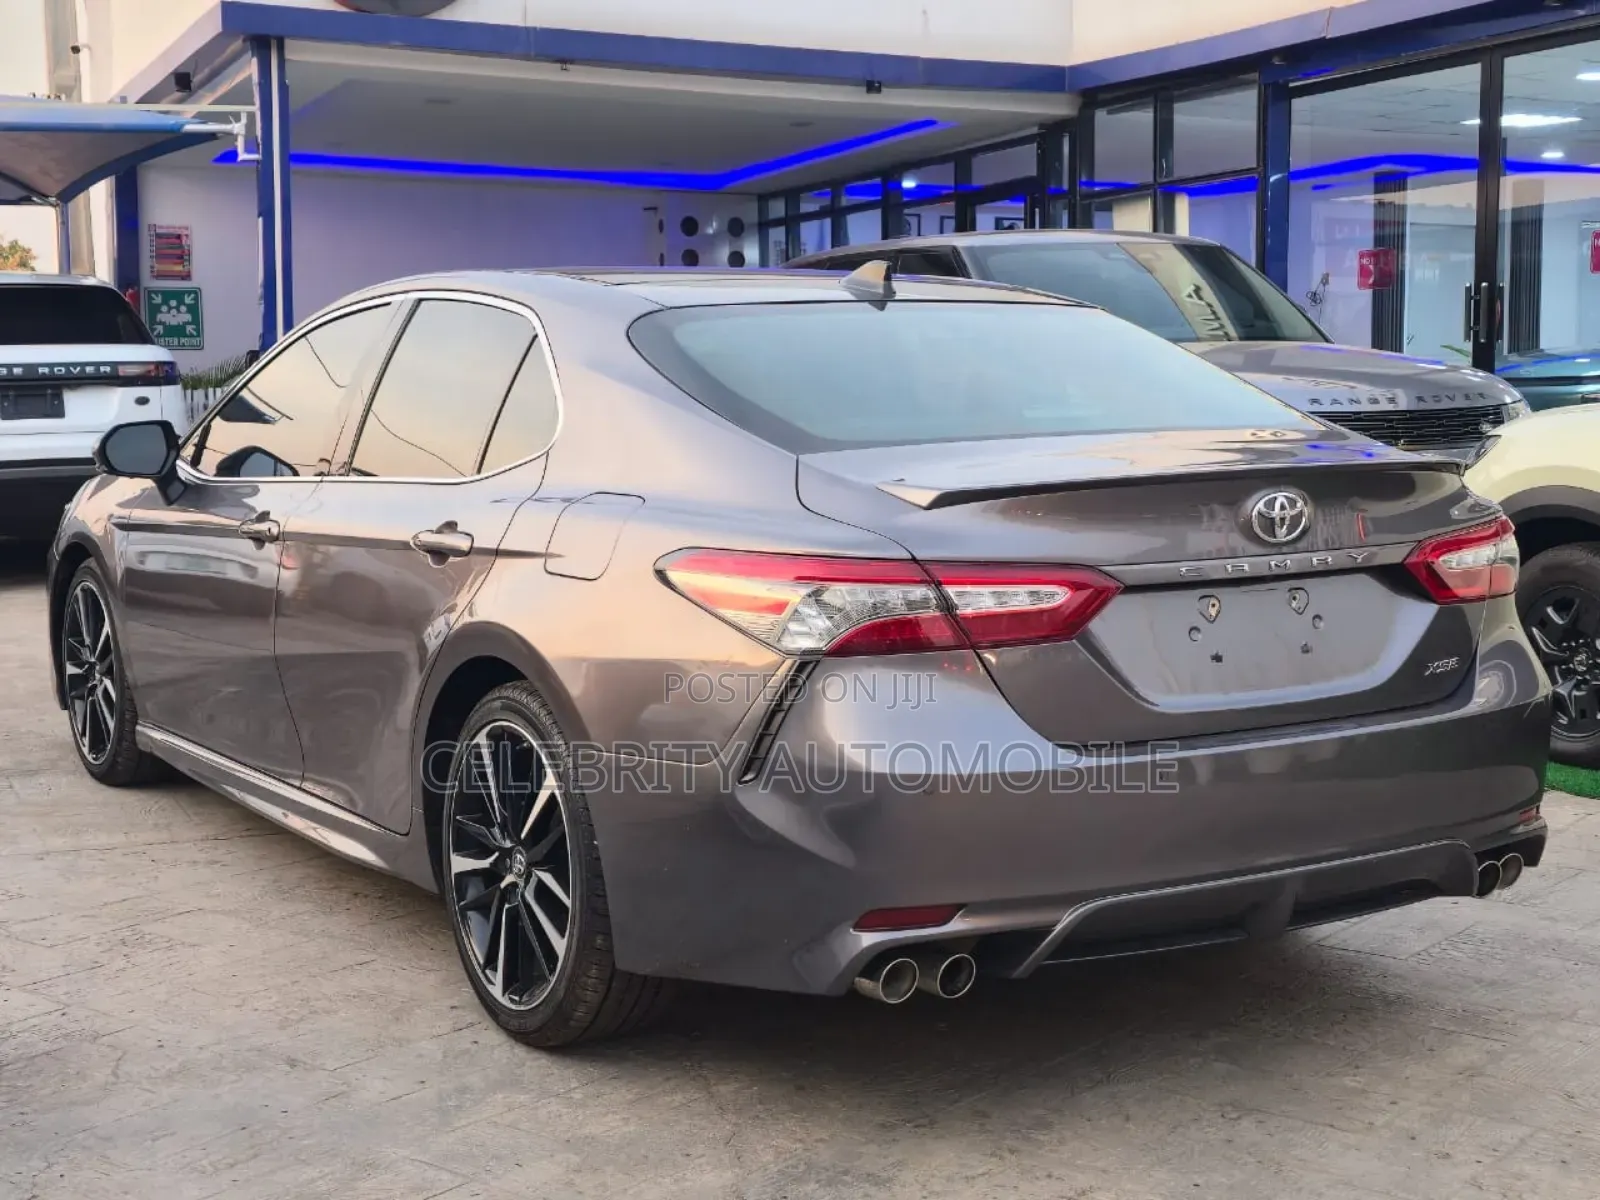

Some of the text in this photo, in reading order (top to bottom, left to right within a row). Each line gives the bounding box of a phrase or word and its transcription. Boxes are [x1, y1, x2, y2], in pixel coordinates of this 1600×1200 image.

[154, 337, 200, 346] USTER POINT
[38, 365, 111, 375] ROVER
[1309, 392, 1486, 406] RANGE ROVER
[1179, 551, 1370, 577] CAMRY
[1424, 656, 1460, 676] XSE
